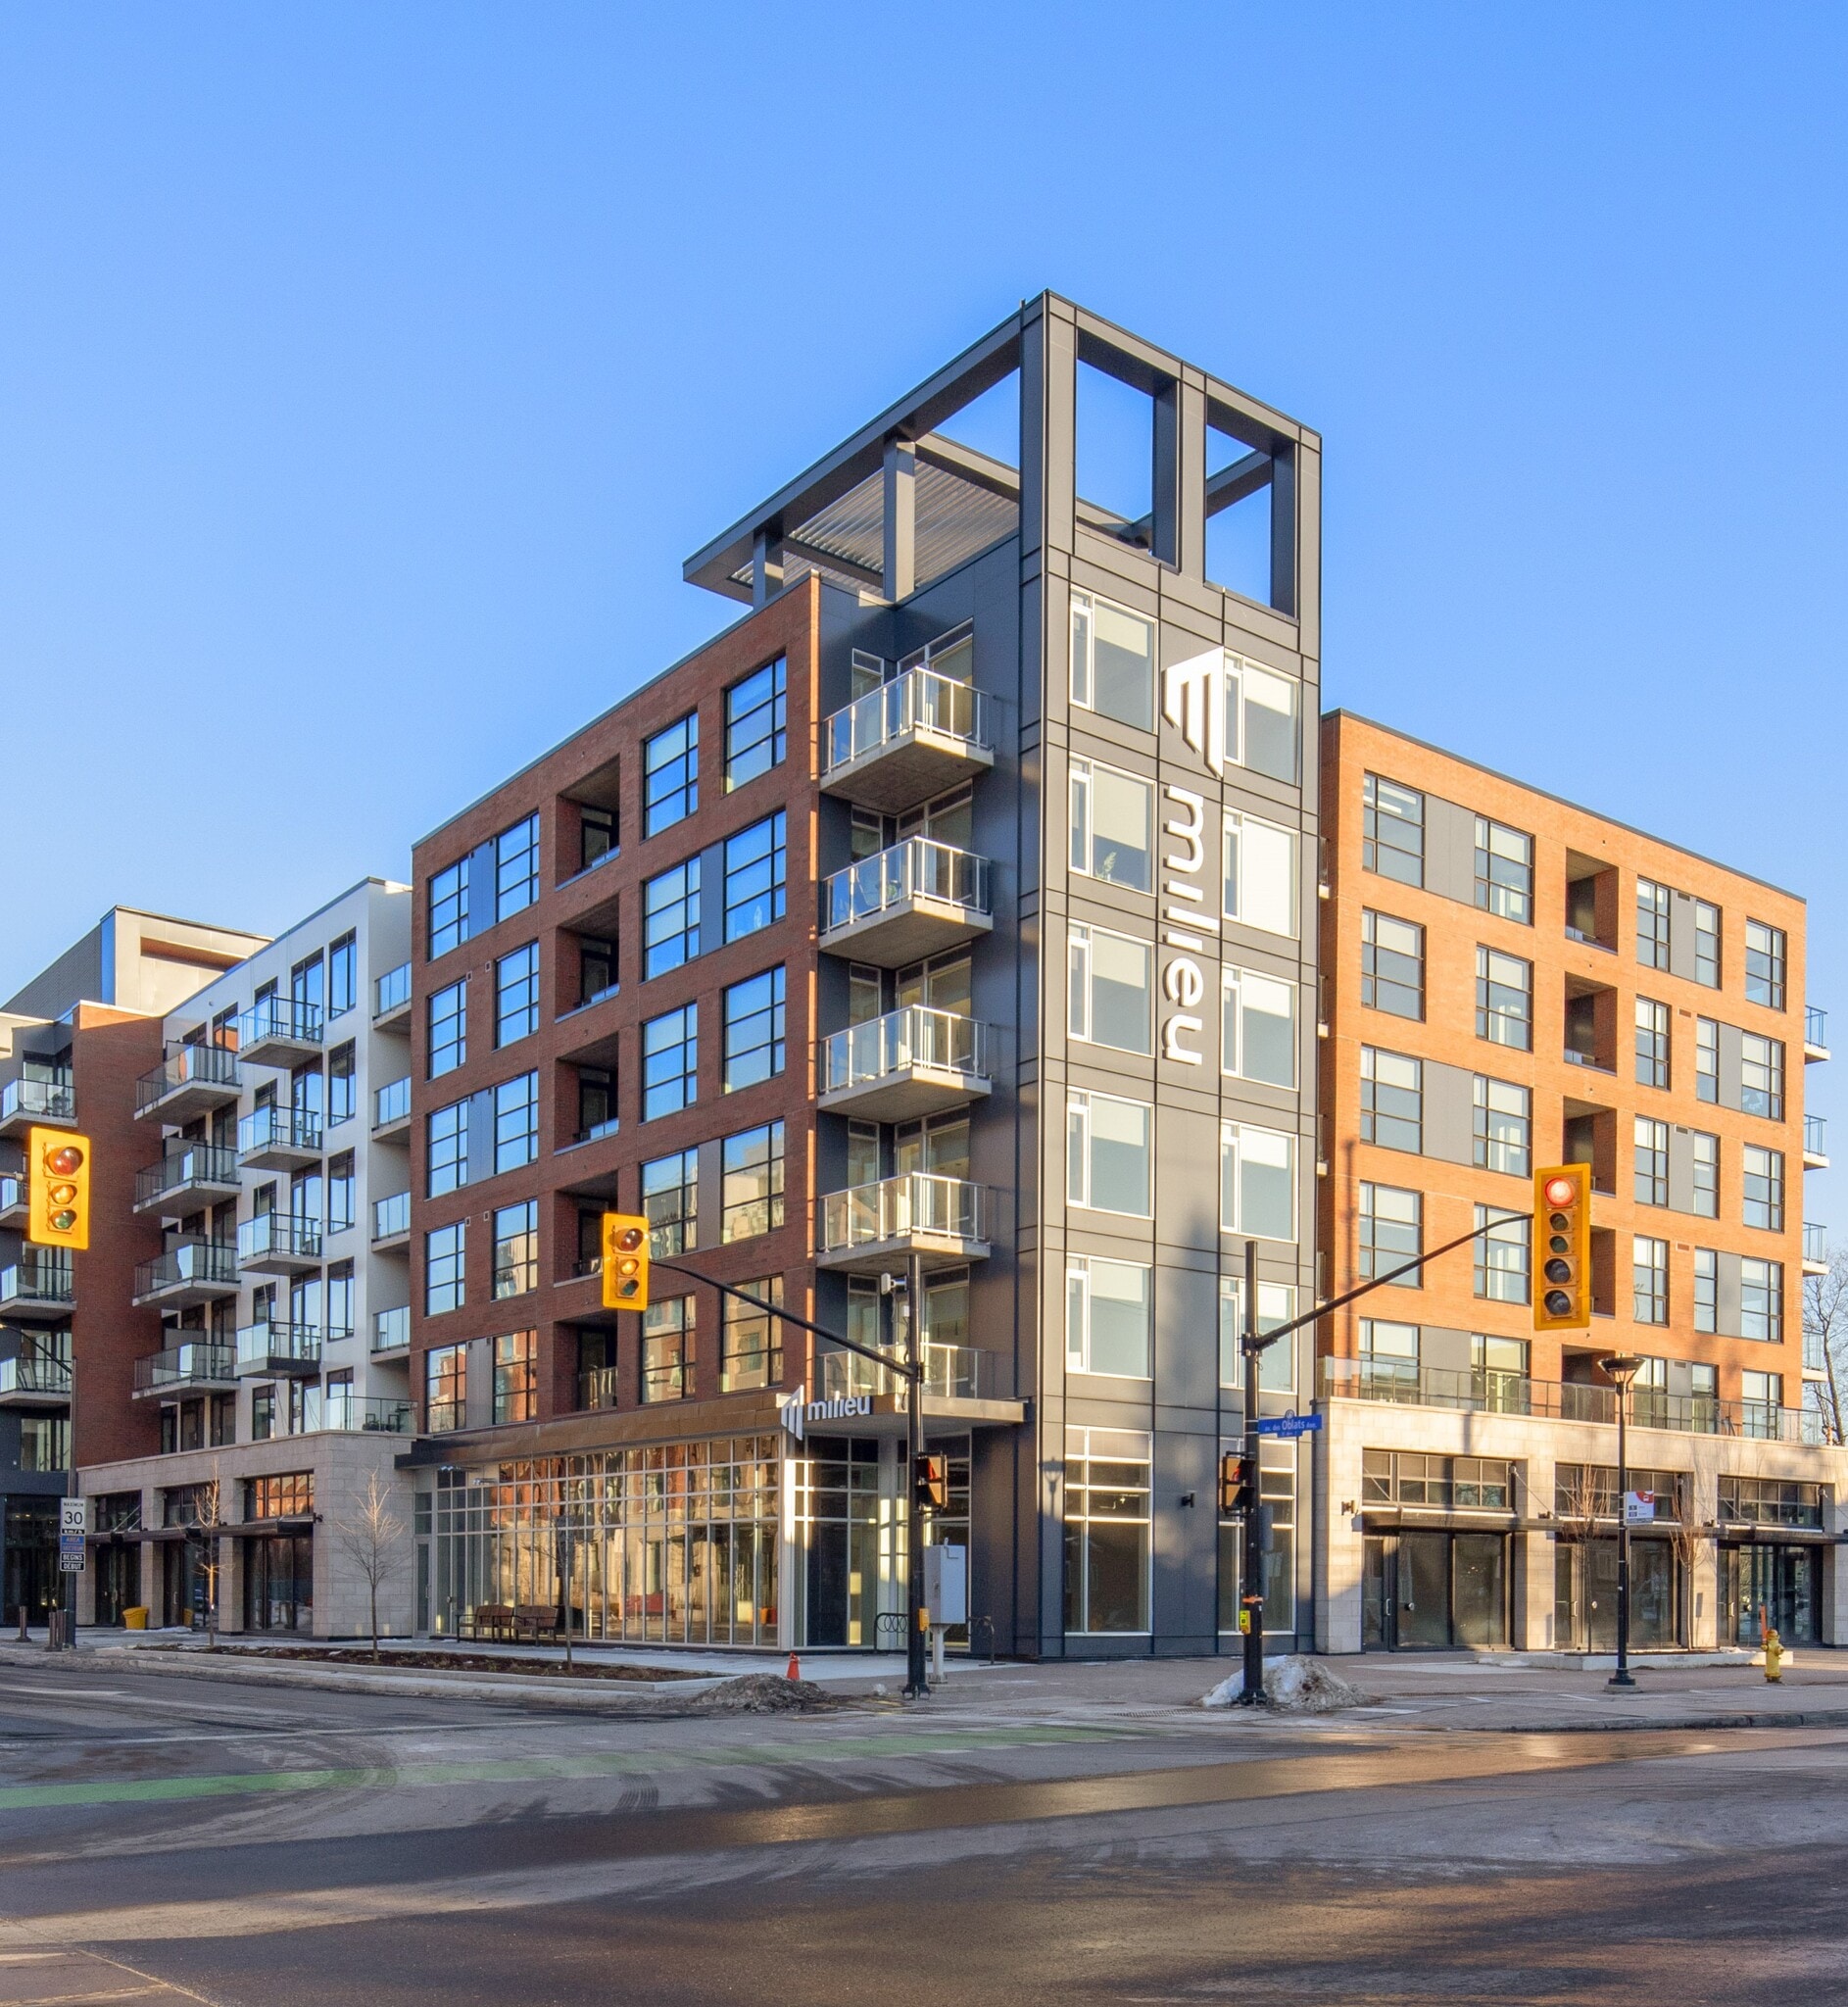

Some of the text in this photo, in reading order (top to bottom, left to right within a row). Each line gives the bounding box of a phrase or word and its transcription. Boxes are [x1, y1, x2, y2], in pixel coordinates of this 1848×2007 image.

[1165, 785, 1219, 1065] milieu
[807, 1390, 871, 1421] milieu
[1282, 1419, 1305, 1430] Oblats
[64, 1510, 83, 1525] 30
